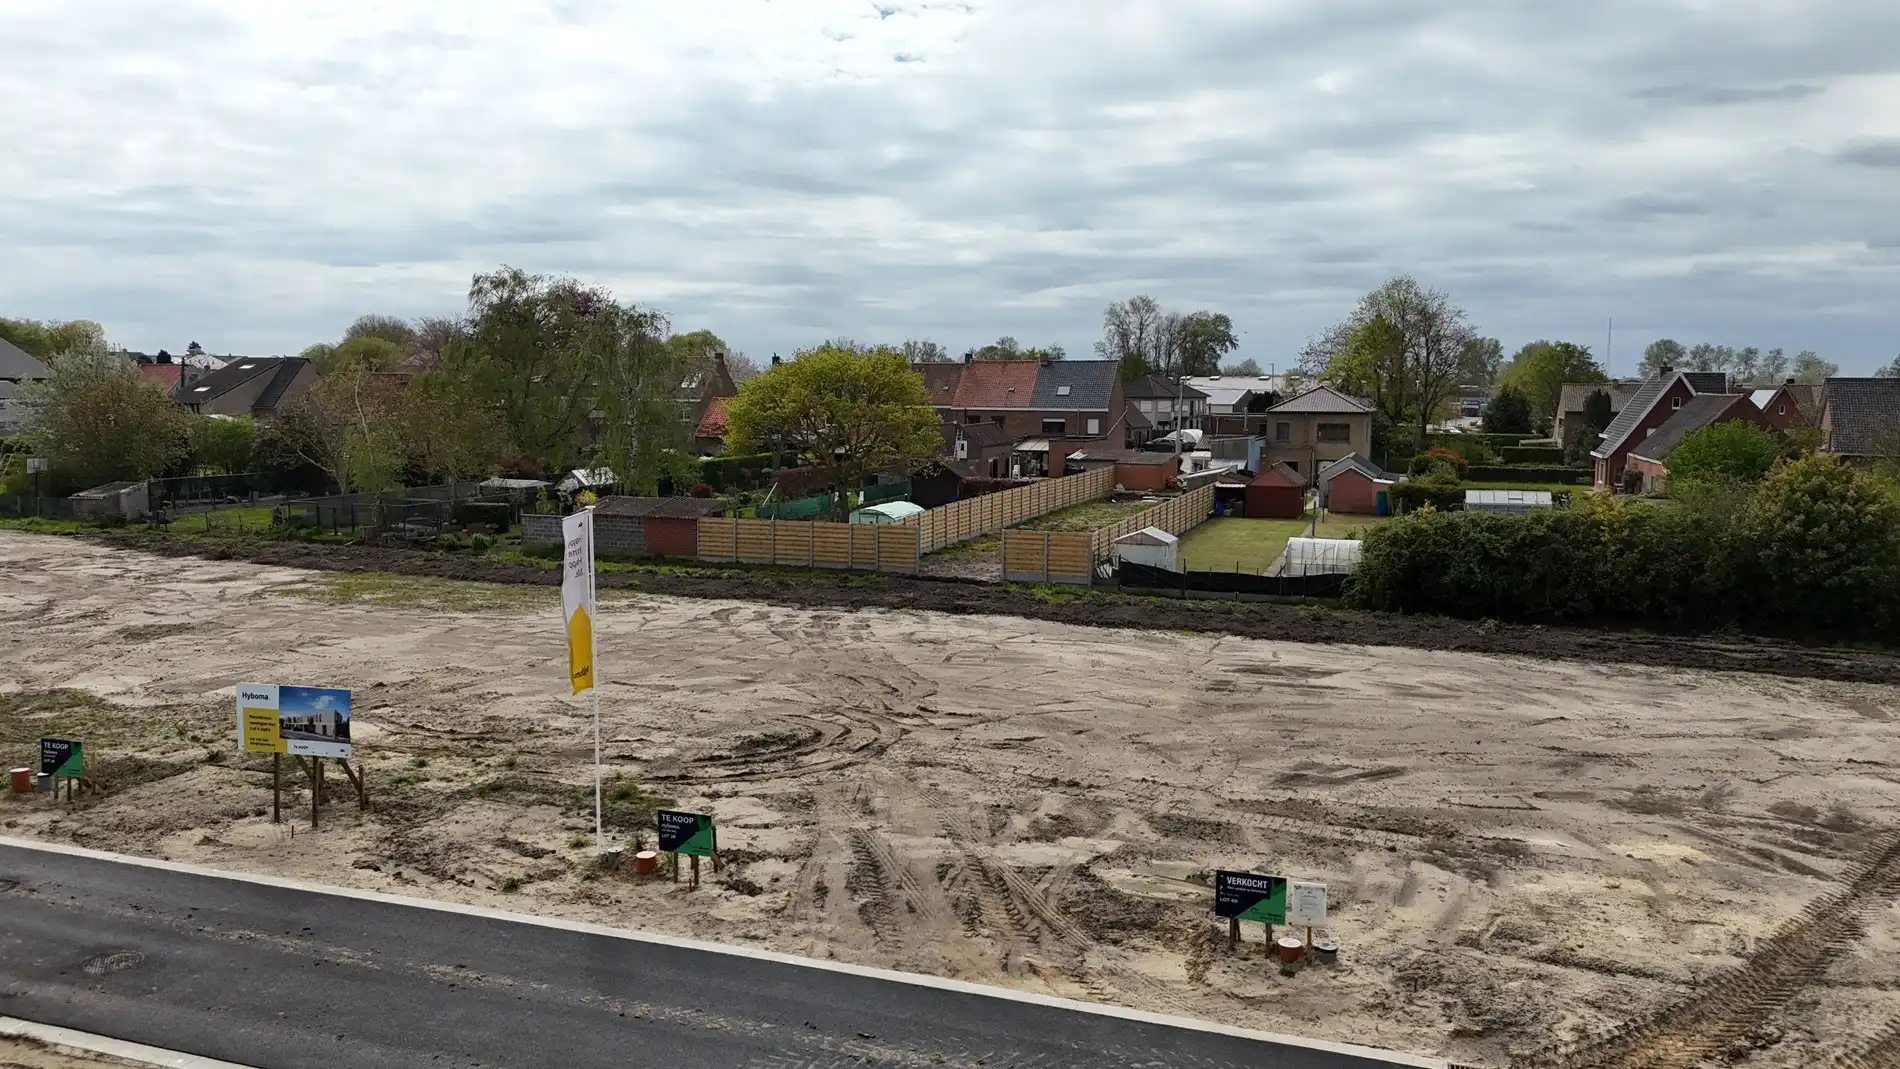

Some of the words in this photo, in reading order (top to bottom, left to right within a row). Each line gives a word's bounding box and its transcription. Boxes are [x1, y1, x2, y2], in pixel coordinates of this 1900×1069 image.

[52, 742, 69, 750] KOOP
[661, 813, 671, 822] TE
[672, 815, 694, 824] KOOP
[1226, 875, 1268, 889] VERKOCHT
